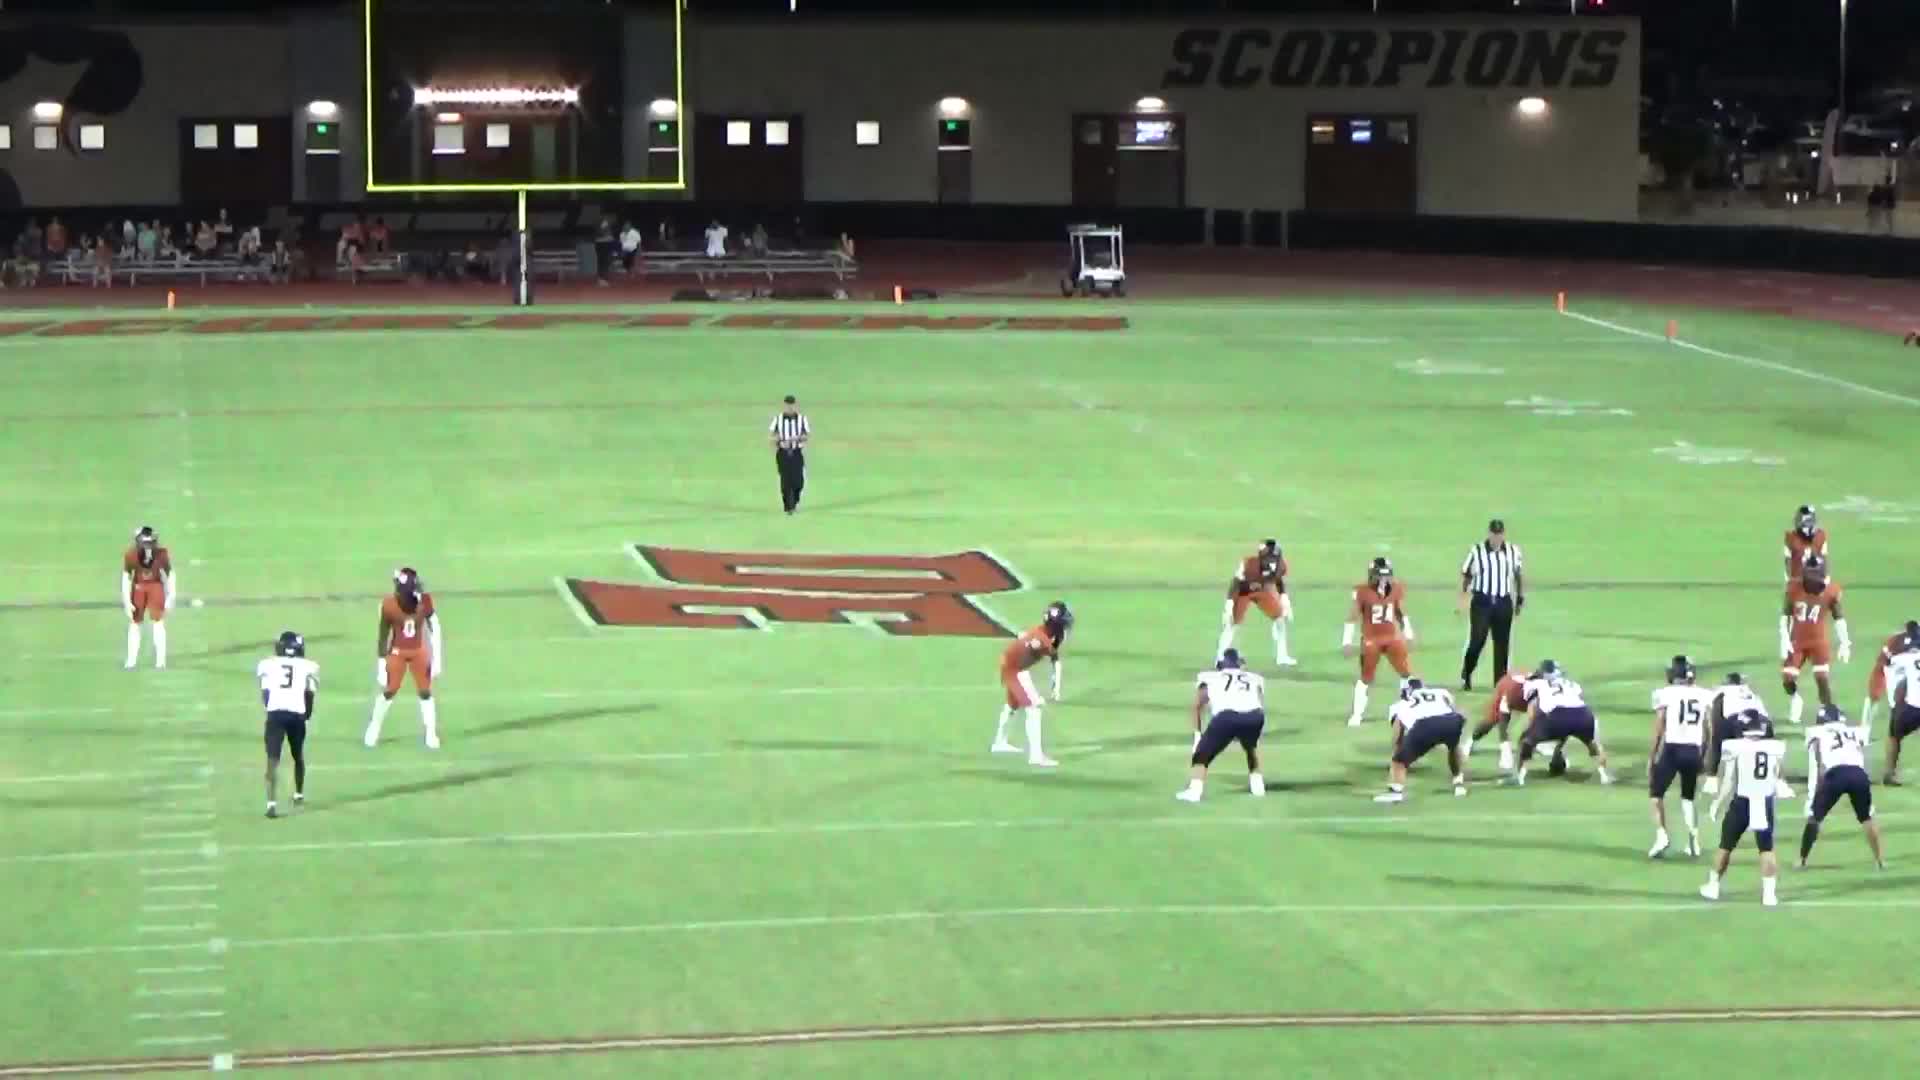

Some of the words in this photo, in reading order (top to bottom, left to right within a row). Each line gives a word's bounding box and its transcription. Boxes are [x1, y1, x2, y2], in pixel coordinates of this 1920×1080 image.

[1160, 29, 1628, 89] SCORPIONS
[1371, 603, 1394, 625] 24
[280, 665, 294, 689] 3
[1221, 673, 1250, 692] 75
[1679, 698, 1700, 726] 15
[1753, 751, 1769, 780] 8
